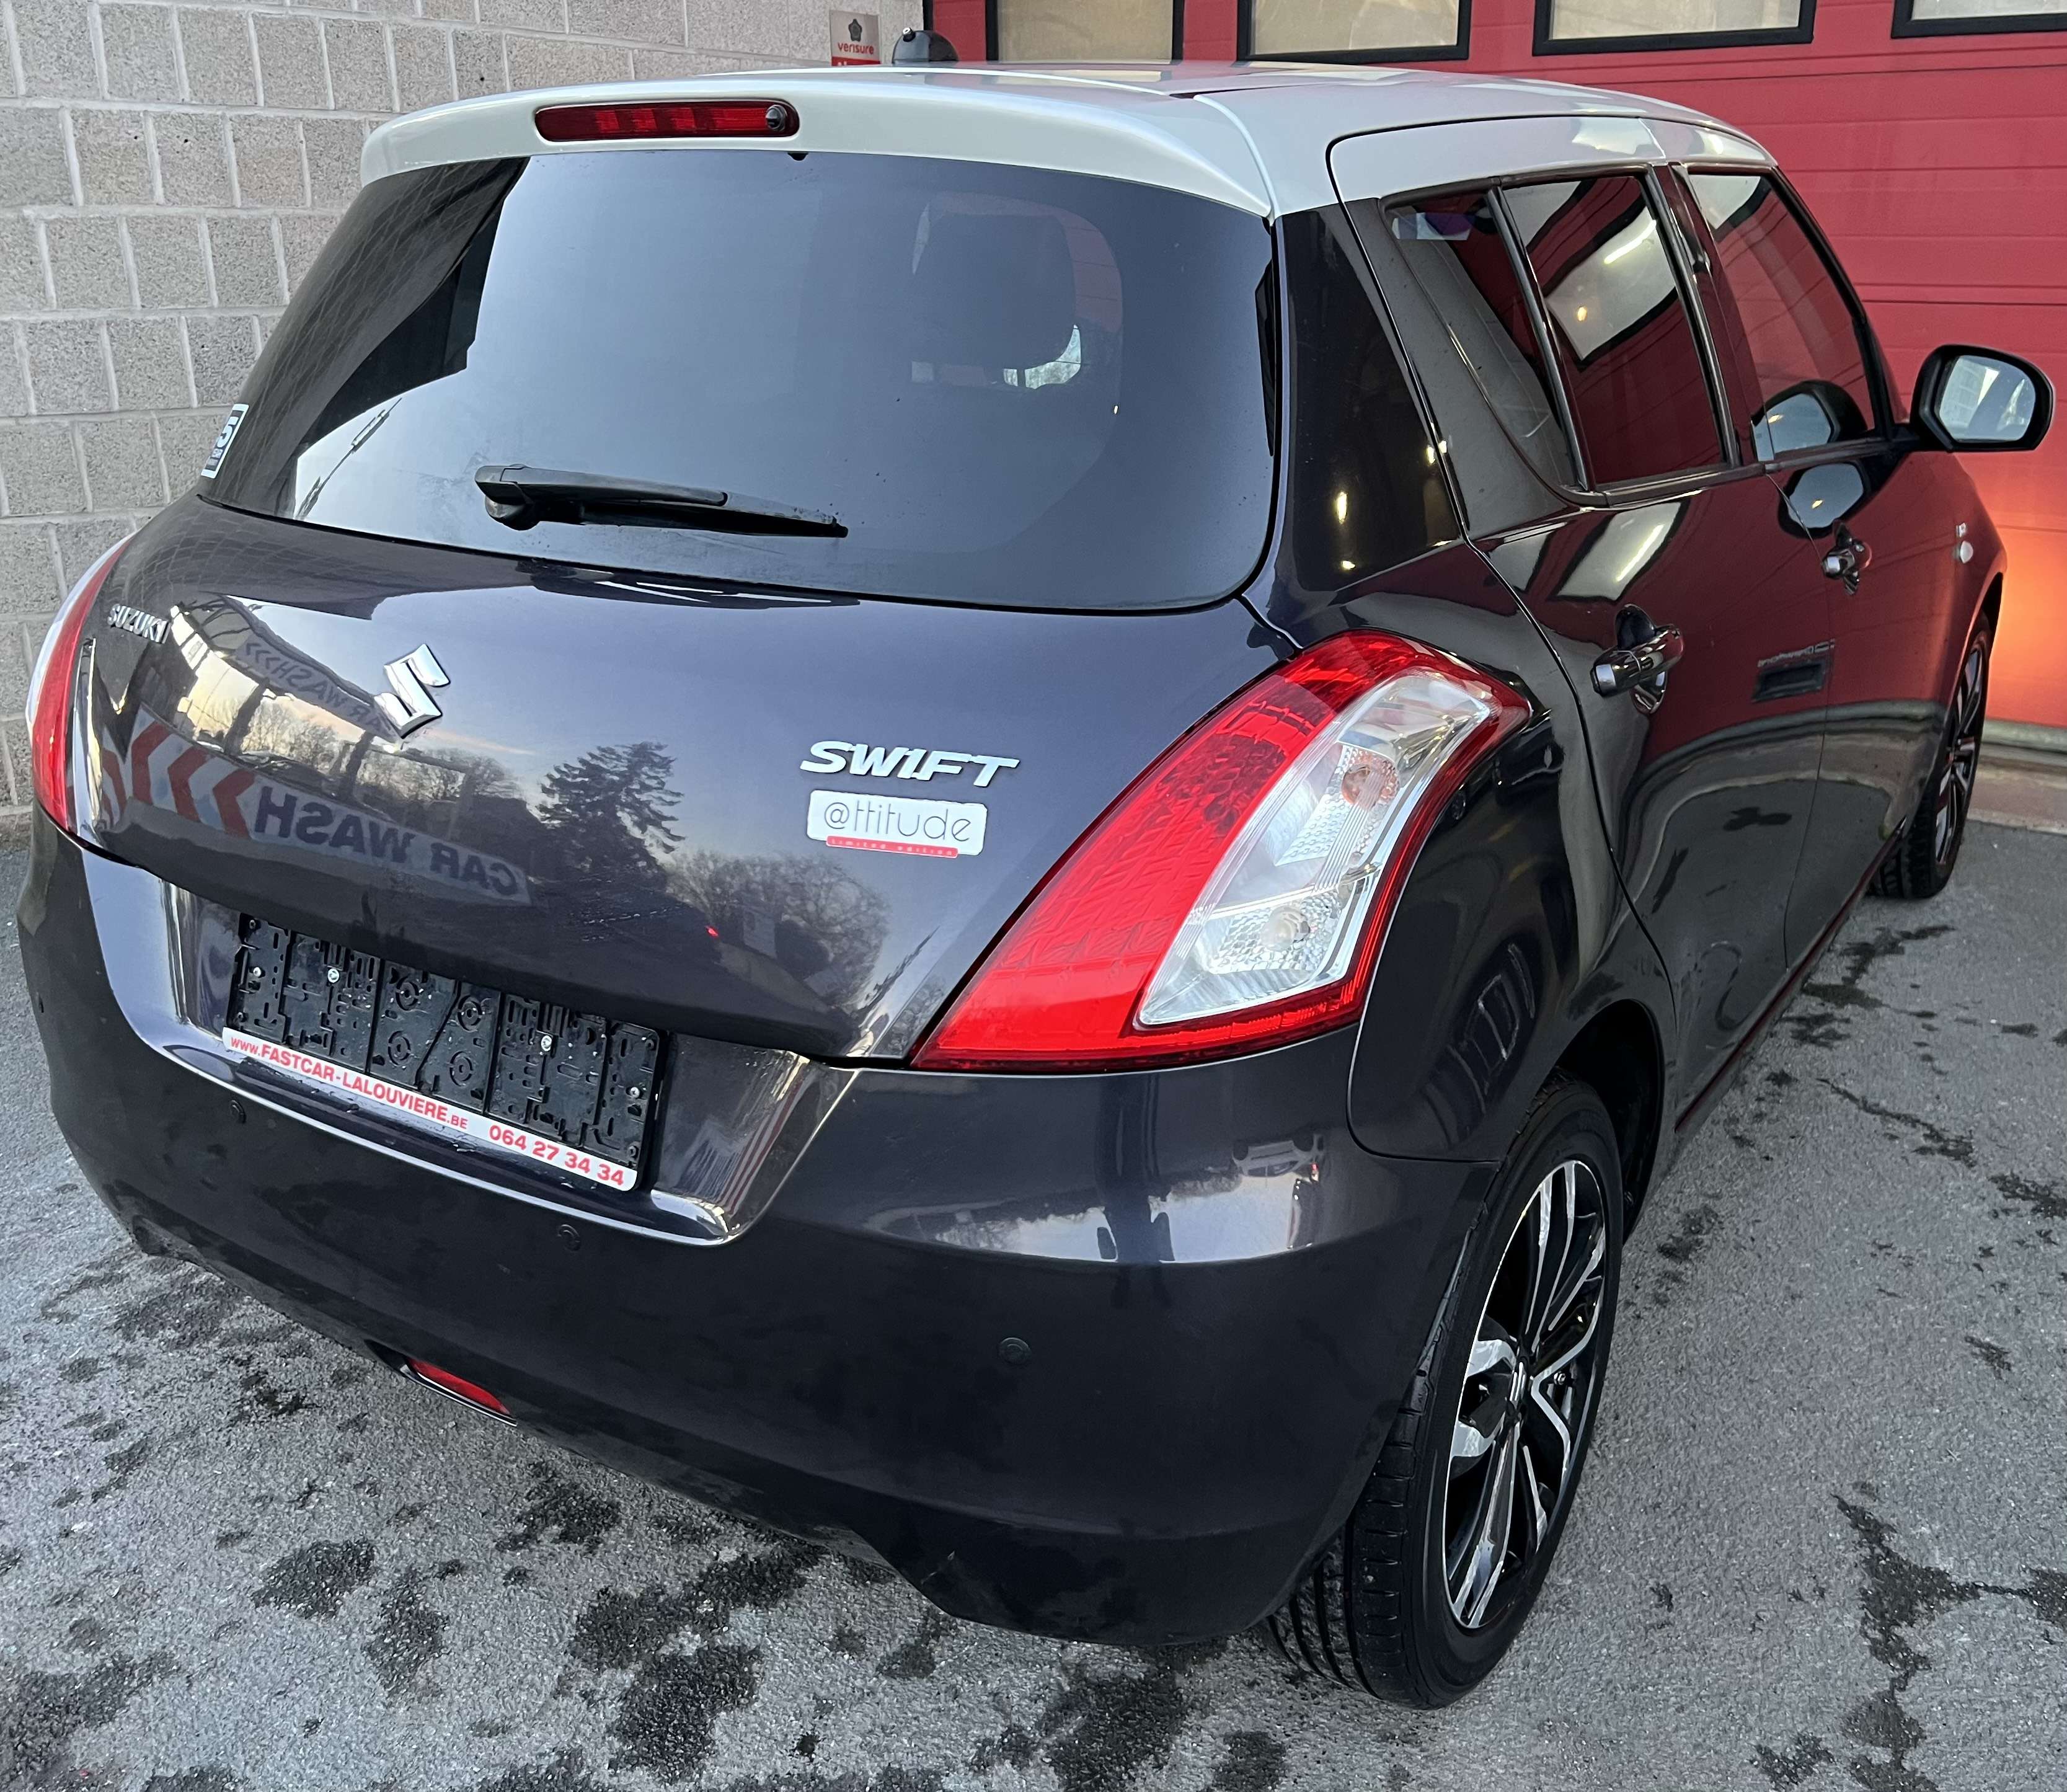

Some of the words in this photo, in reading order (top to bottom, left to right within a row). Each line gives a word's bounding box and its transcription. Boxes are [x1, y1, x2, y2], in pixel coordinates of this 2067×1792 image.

[838, 42, 874, 55] verisure
[107, 603, 171, 644] SUZUKI
[800, 741, 1020, 787] SWIFT
[824, 801, 971, 842] @ttitude
[489, 1125, 526, 1150] 064
[533, 1141, 559, 1160] 27
[565, 1152, 590, 1173] 34
[597, 1164, 624, 1186] 34
